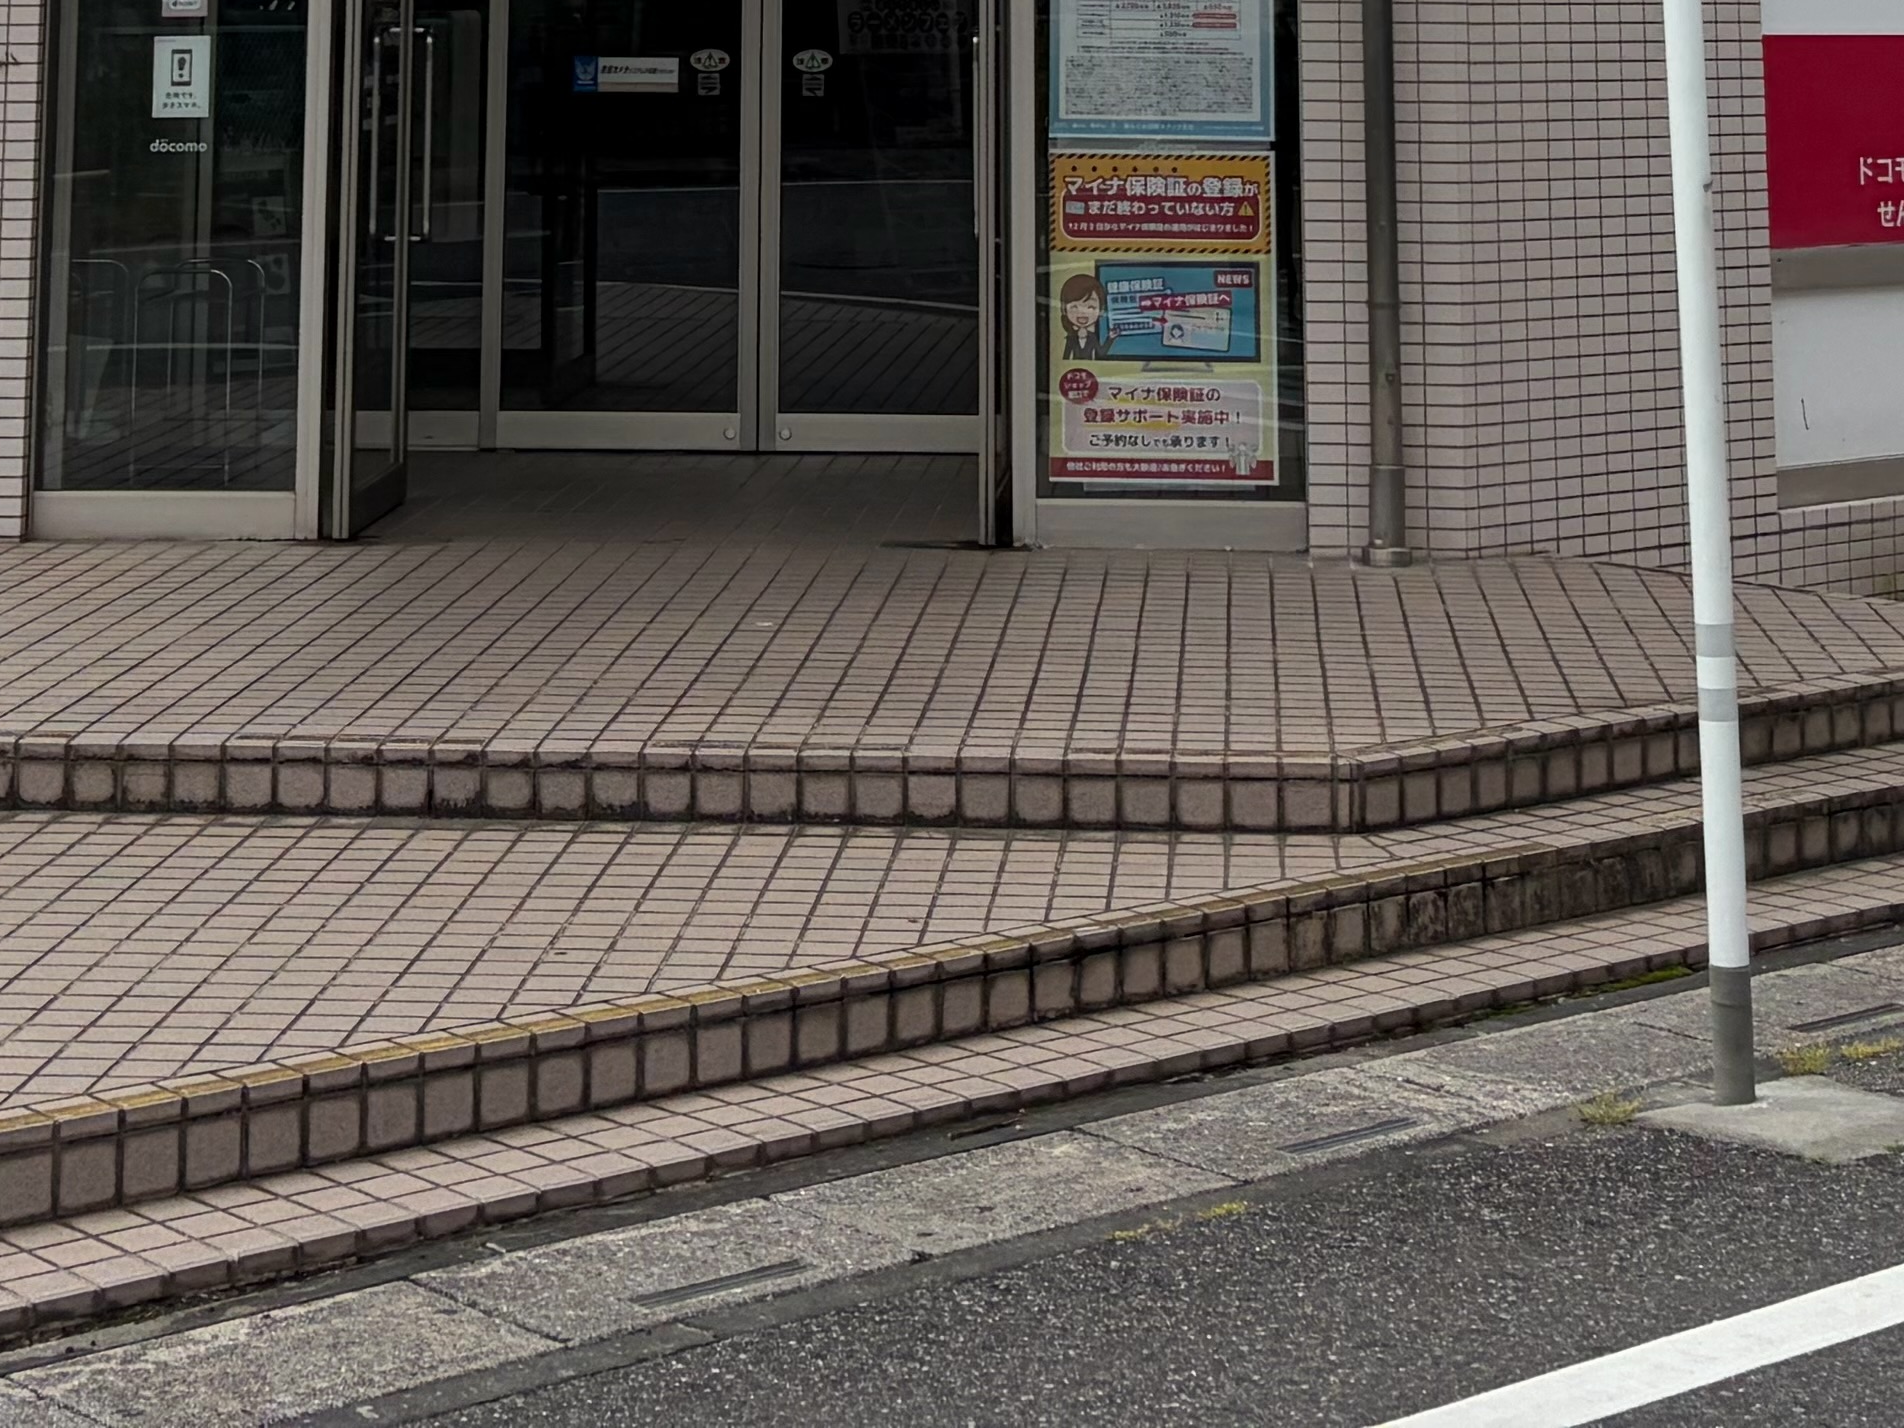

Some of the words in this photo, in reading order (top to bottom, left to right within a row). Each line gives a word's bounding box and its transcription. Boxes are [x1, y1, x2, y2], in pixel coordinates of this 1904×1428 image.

[149, 138, 207, 153] docomo
[1064, 176, 1259, 198] マイナ保険証の登録が
[1216, 274, 1250, 285] NEWS
[1108, 386, 1221, 403] マイナ保険証の
